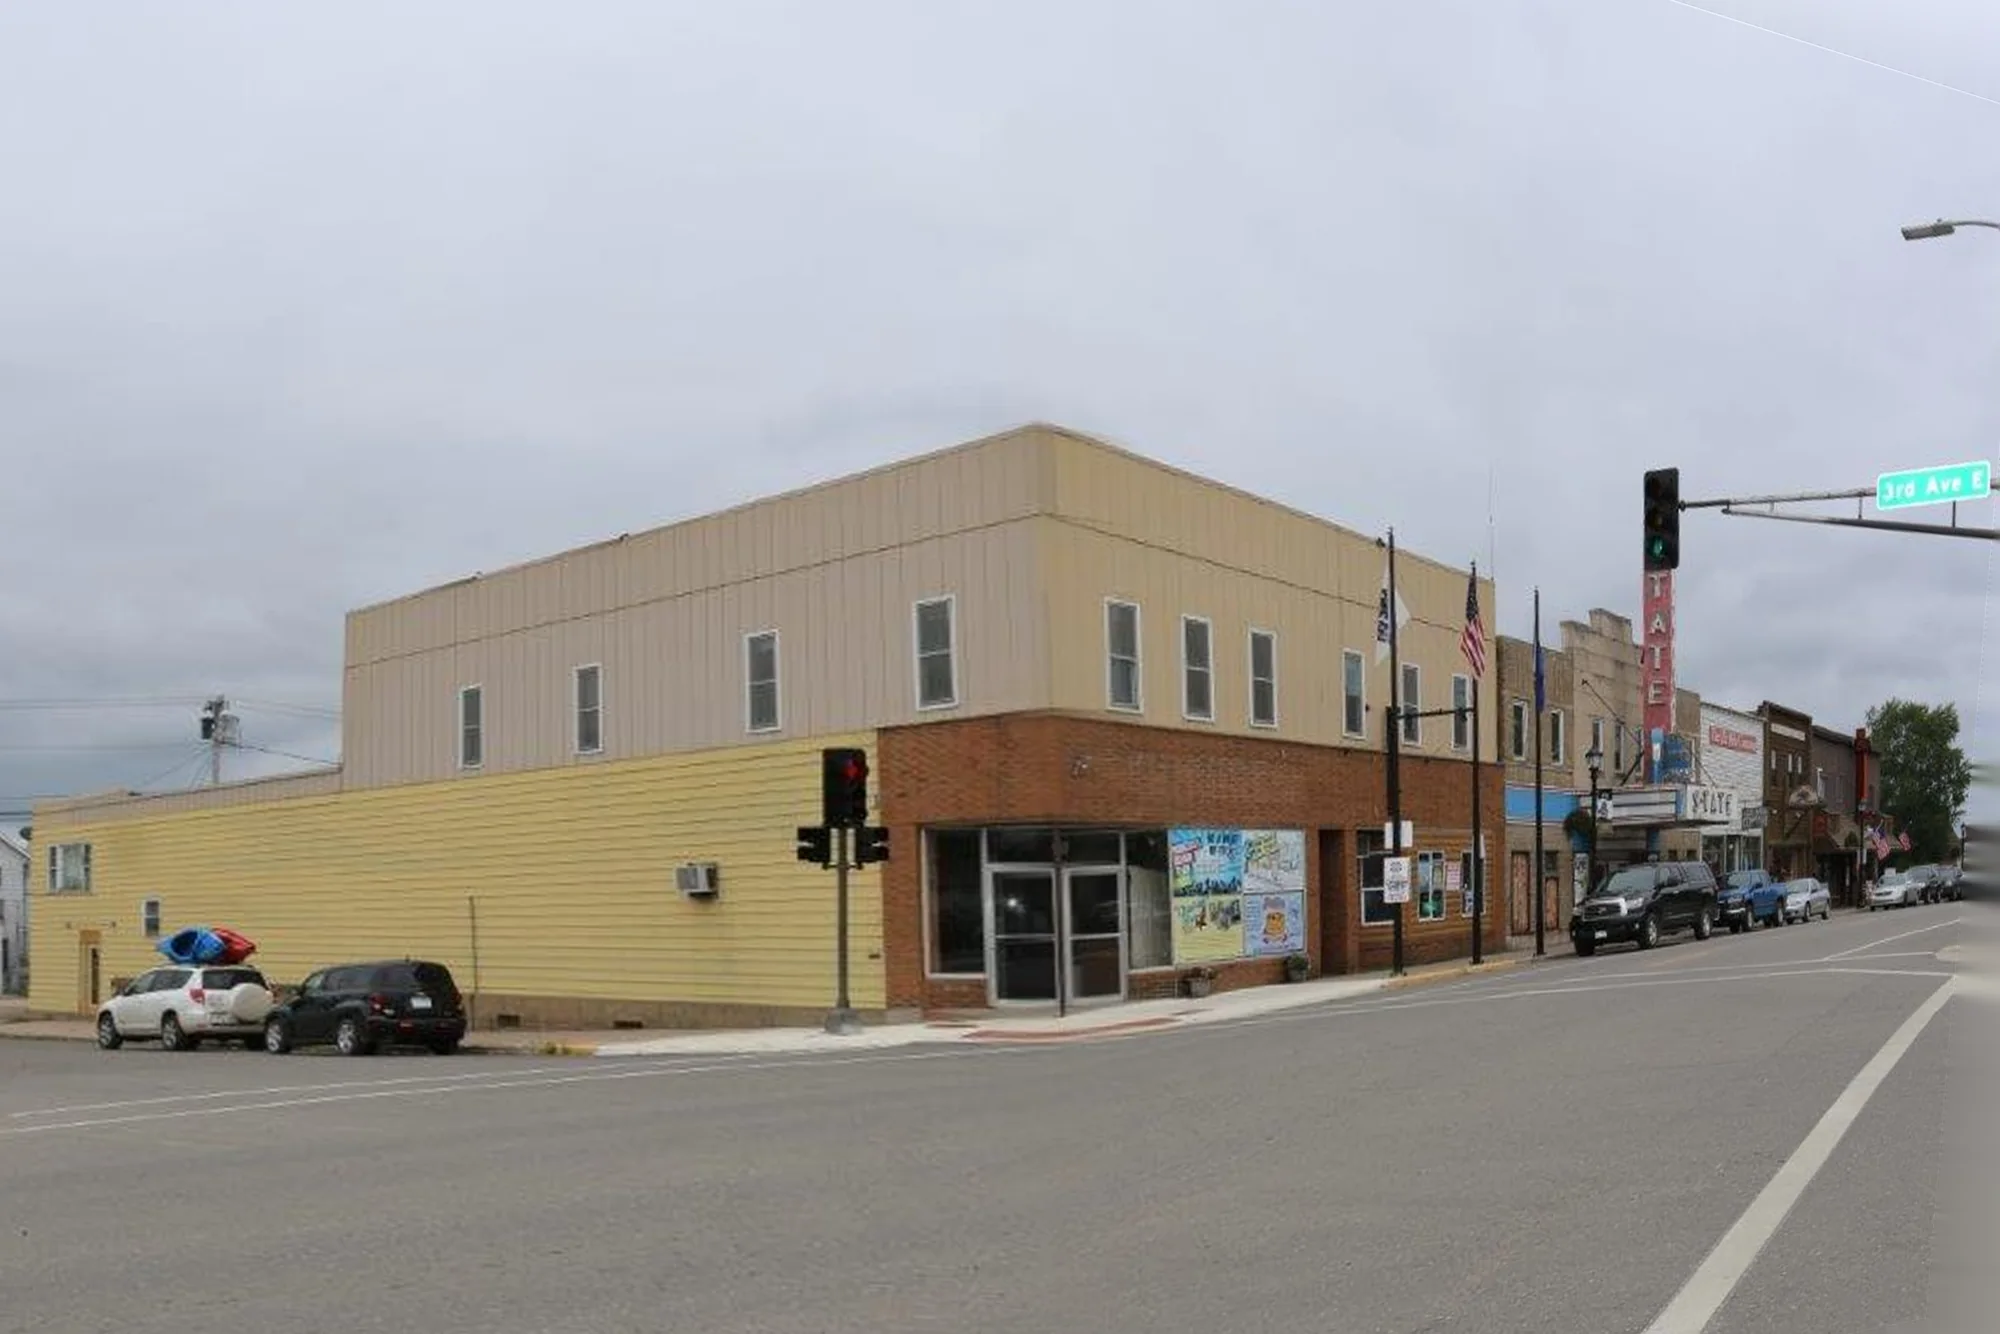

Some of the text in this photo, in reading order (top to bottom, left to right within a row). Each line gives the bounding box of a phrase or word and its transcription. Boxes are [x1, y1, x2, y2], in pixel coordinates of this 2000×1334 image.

[1884, 470, 1984, 499] 3rd Ave E
[1648, 571, 1669, 705] TATE
[1691, 789, 1733, 817] STATE
